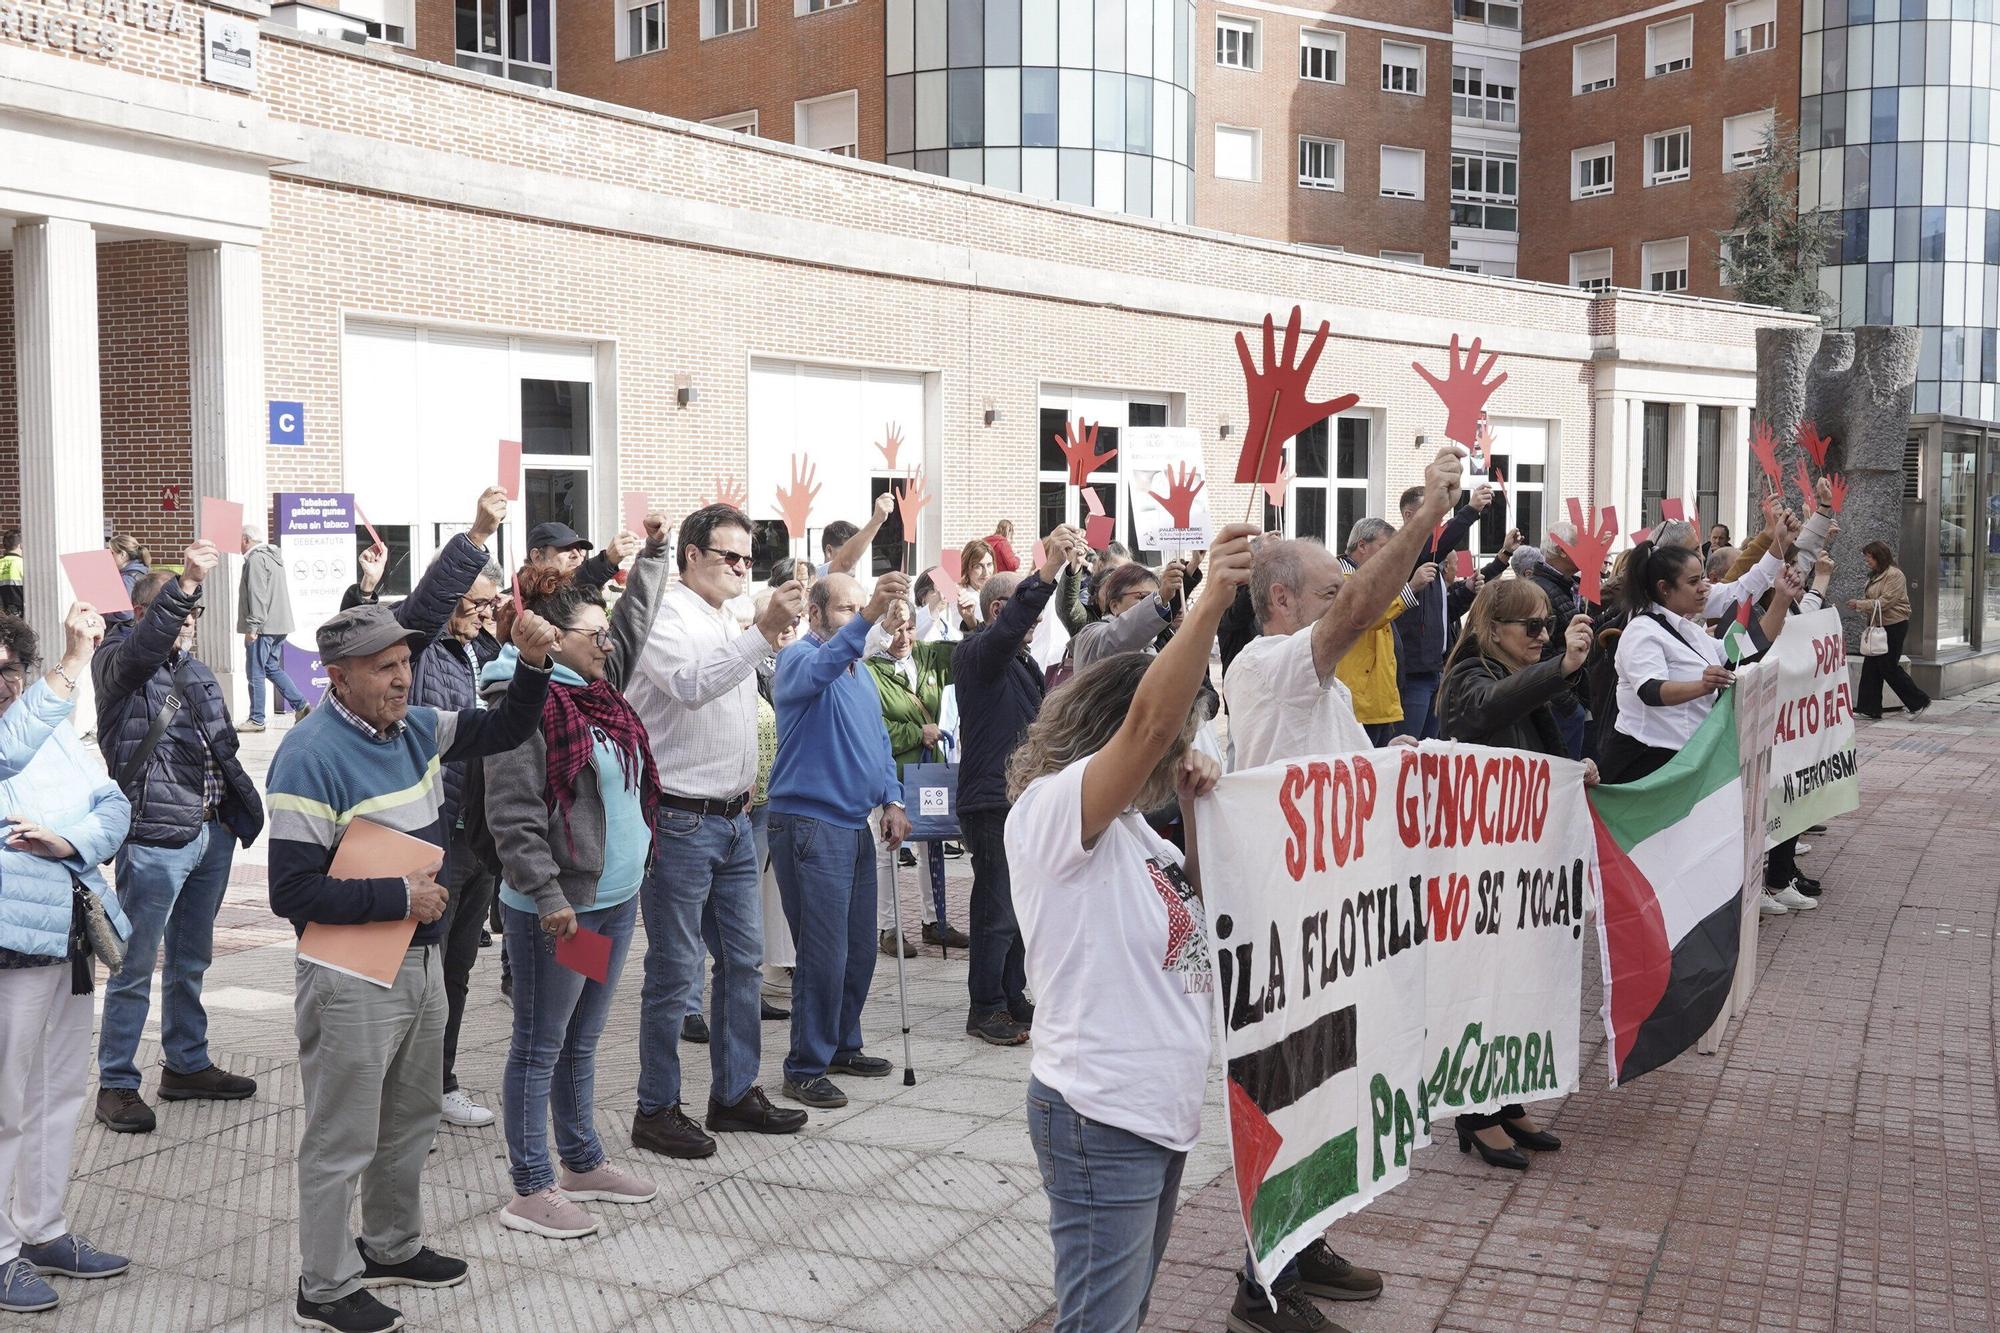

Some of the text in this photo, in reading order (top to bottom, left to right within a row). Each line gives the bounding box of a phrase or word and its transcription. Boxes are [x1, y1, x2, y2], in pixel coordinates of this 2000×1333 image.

[279, 413, 295, 432] C
[291, 507, 346, 517] gabeko gunea
[299, 498, 338, 507] Tabakorik
[309, 520, 321, 529] sin
[323, 520, 350, 529] tabaco
[1774, 694, 1820, 745] ALTO
[1824, 690, 1835, 729] EL
[1280, 750, 1550, 882] STOP GENOCIDIO
[1302, 874, 1428, 1000] FLOTILL
[1427, 872, 1470, 942] NO
[1475, 870, 1504, 935] SE
[1517, 858, 1584, 940] TOCA!
